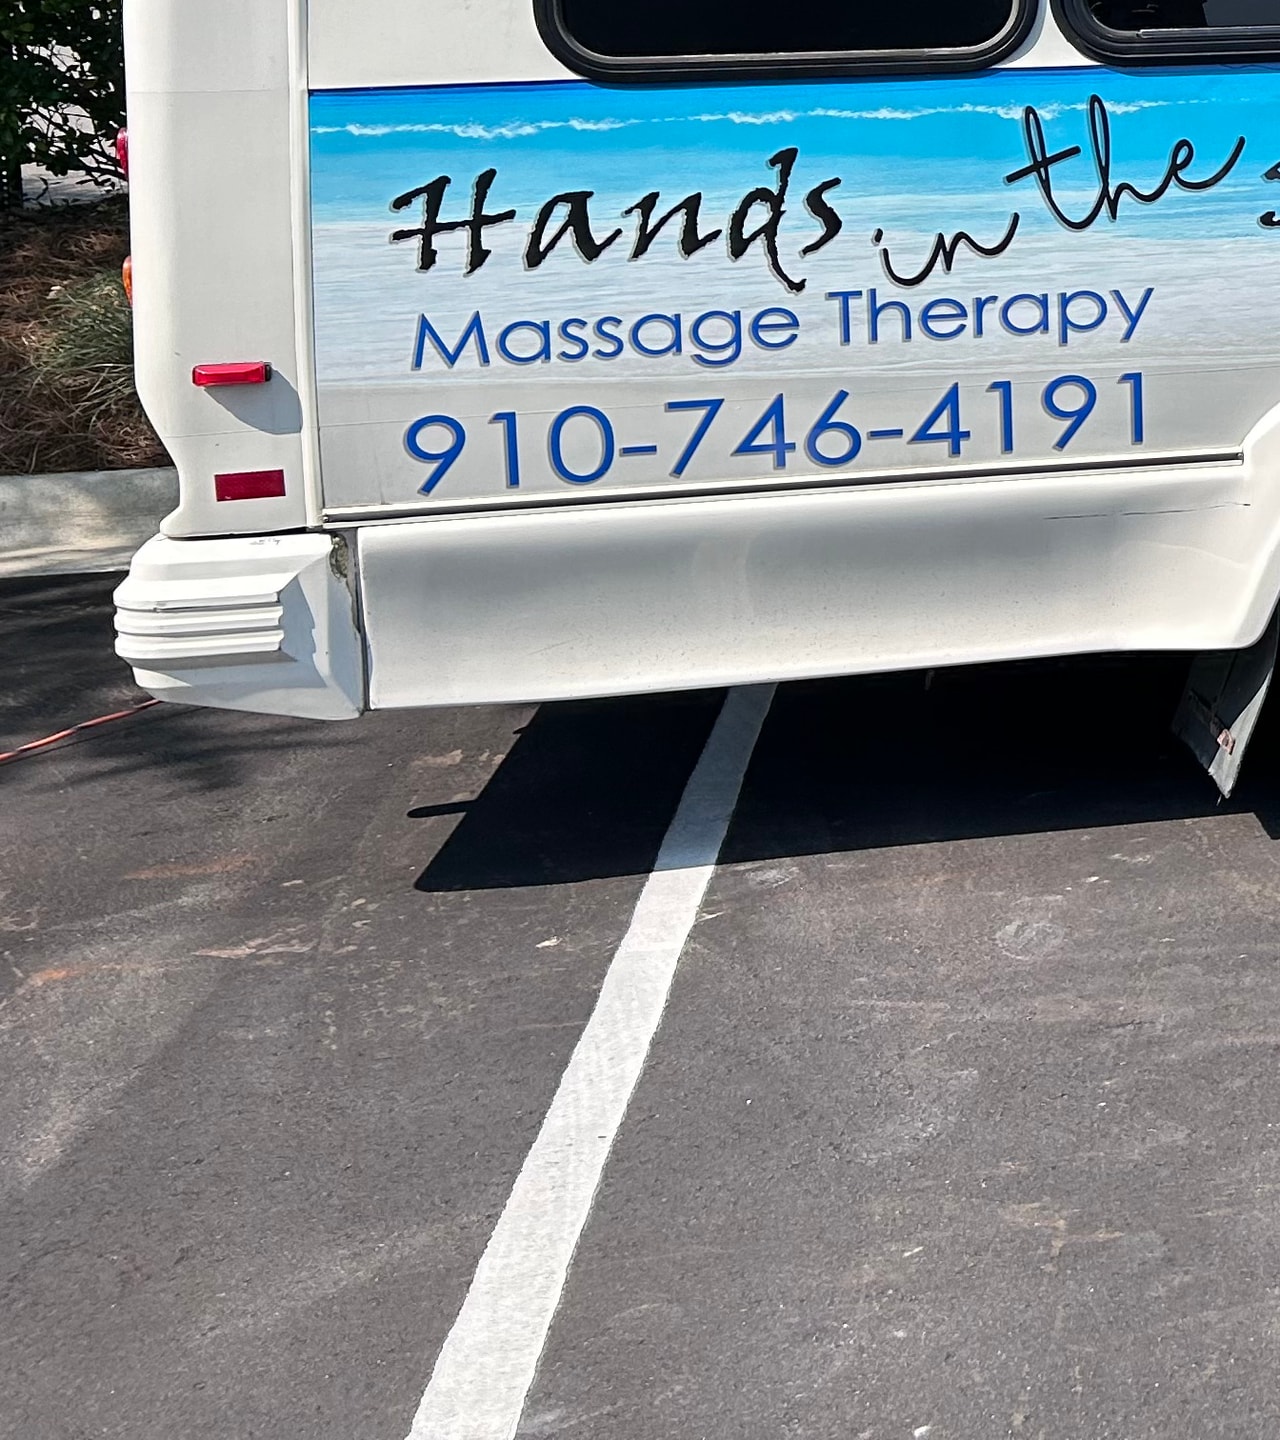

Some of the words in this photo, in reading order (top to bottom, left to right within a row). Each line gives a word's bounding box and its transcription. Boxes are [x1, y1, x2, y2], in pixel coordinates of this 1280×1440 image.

[390, 147, 843, 294] Hands
[873, 211, 1021, 287] in
[1004, 93, 1247, 232] the
[411, 306, 801, 372] Massage
[823, 286, 1156, 348] Therapy
[403, 370, 1147, 496] 910-746-4191
